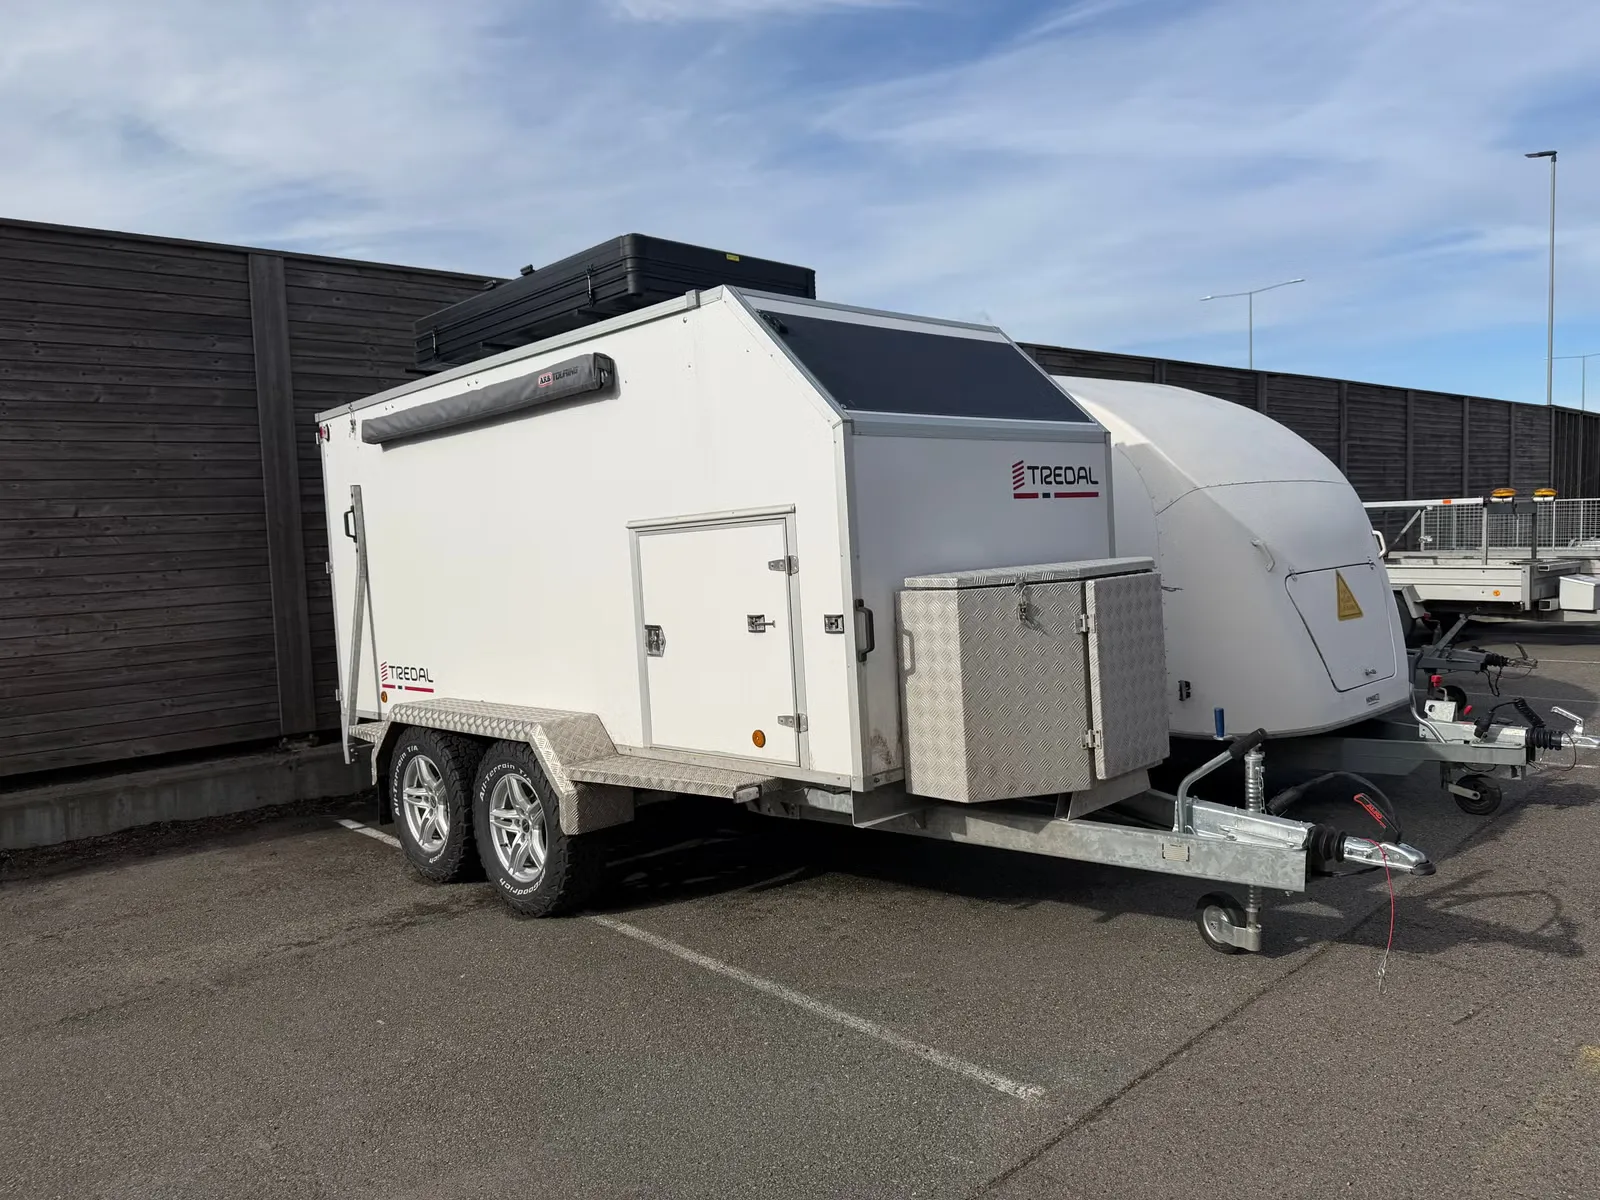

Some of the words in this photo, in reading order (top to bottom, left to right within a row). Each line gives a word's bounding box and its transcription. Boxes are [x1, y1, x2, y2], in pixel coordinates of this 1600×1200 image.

[1026, 465, 1099, 485] TREDAL
[388, 665, 434, 683] TREDAL
[479, 762, 515, 802] All-Terrain
